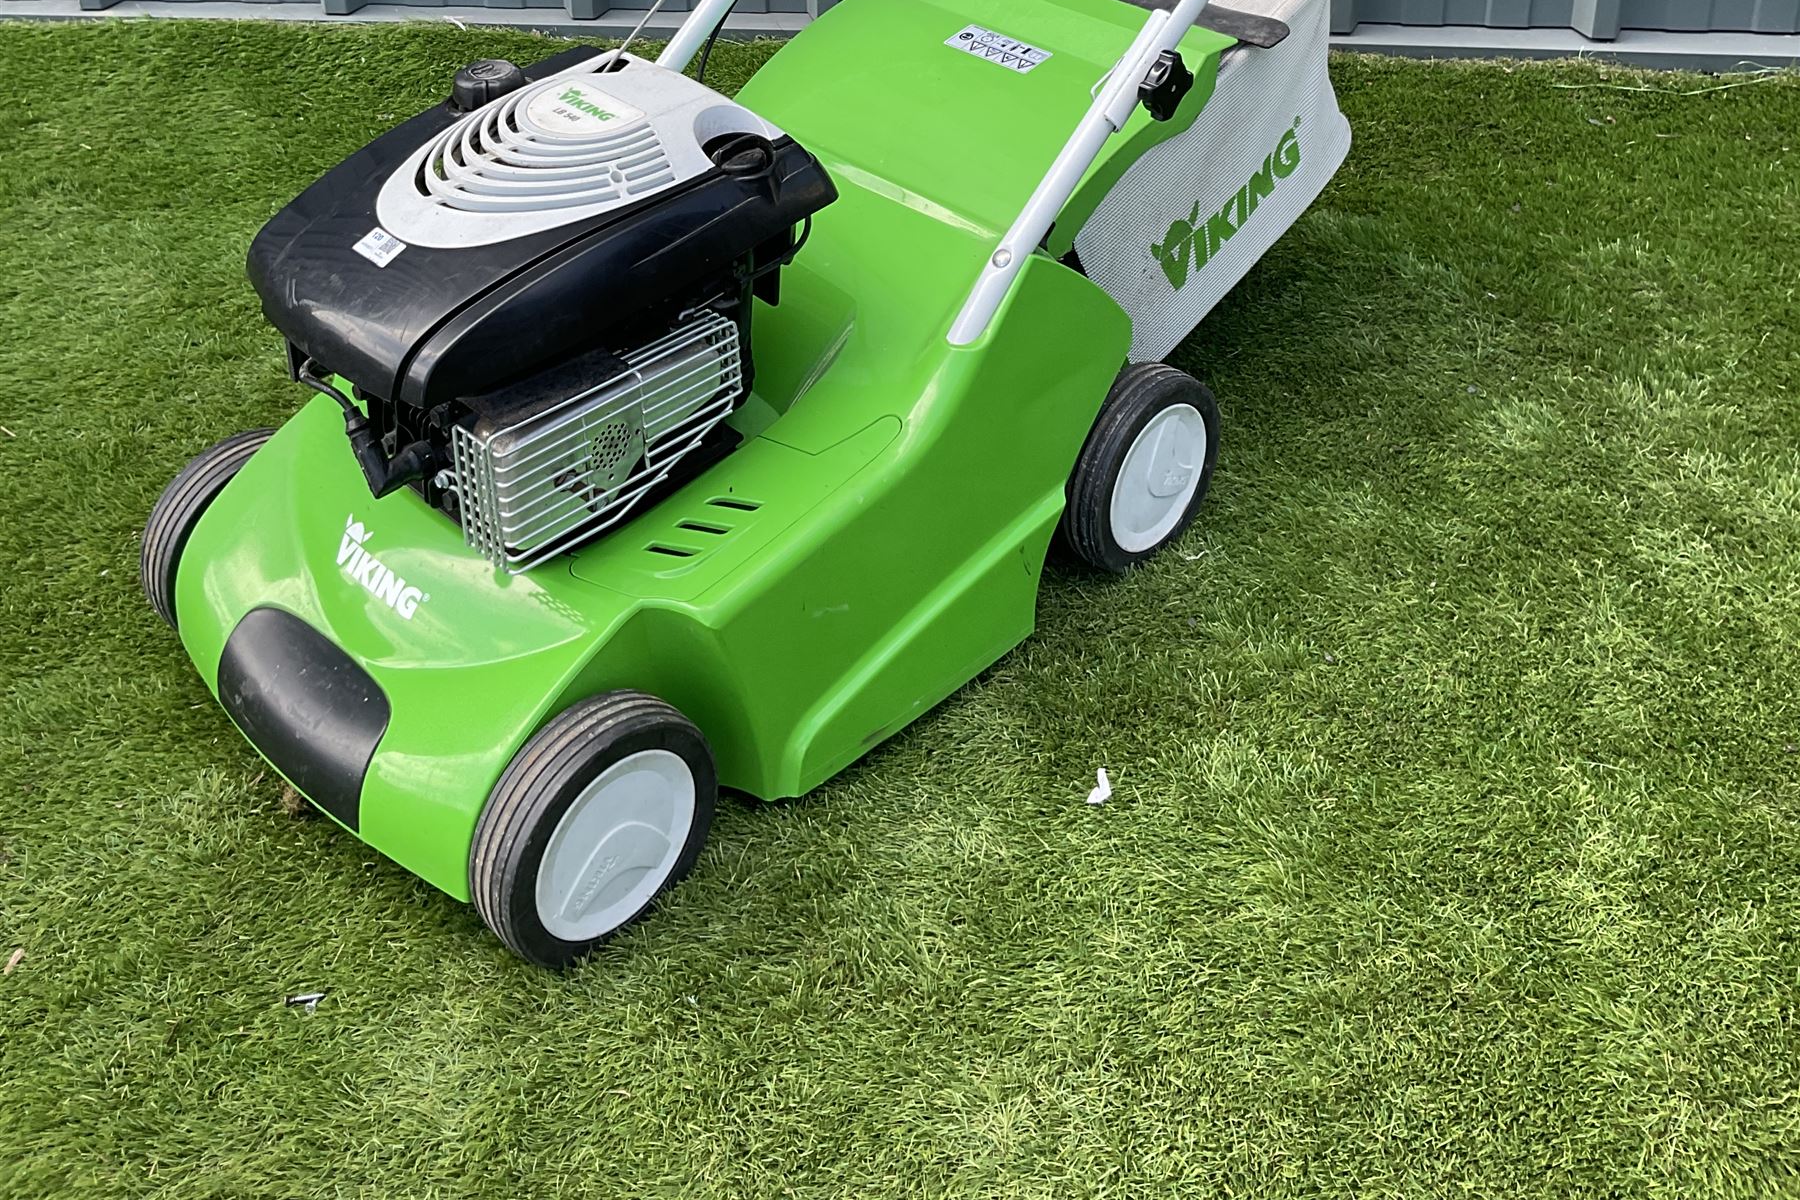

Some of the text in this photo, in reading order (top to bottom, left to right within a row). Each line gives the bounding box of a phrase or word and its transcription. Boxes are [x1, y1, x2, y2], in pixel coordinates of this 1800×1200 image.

[553, 107, 567, 115] LB
[559, 91, 616, 121] VIKING
[1159, 127, 1302, 291] VIKING
[335, 531, 424, 621] VIKING
